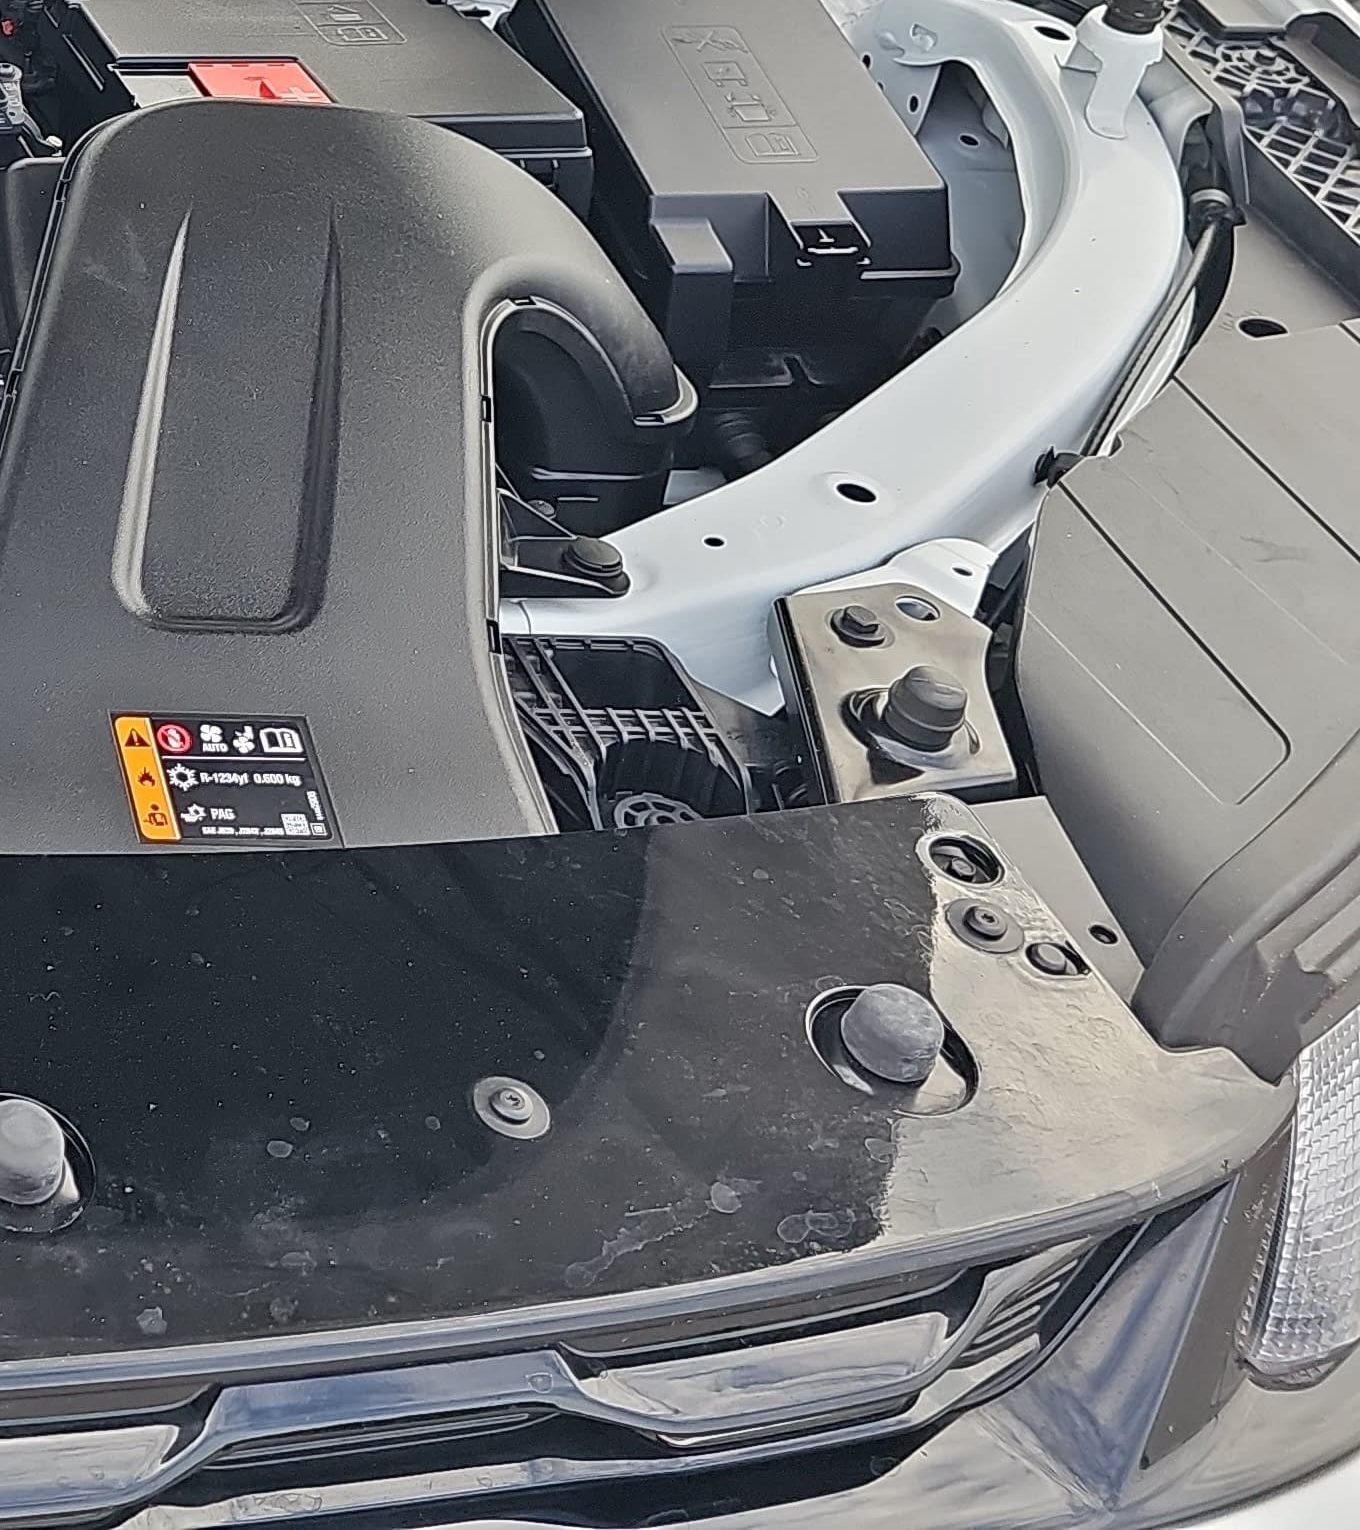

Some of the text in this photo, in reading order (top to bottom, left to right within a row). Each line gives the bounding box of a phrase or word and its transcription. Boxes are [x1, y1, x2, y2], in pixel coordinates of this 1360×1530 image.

[202, 742, 229, 753] AUTO
[285, 773, 302, 787] kg
[210, 808, 236, 820] PAG
